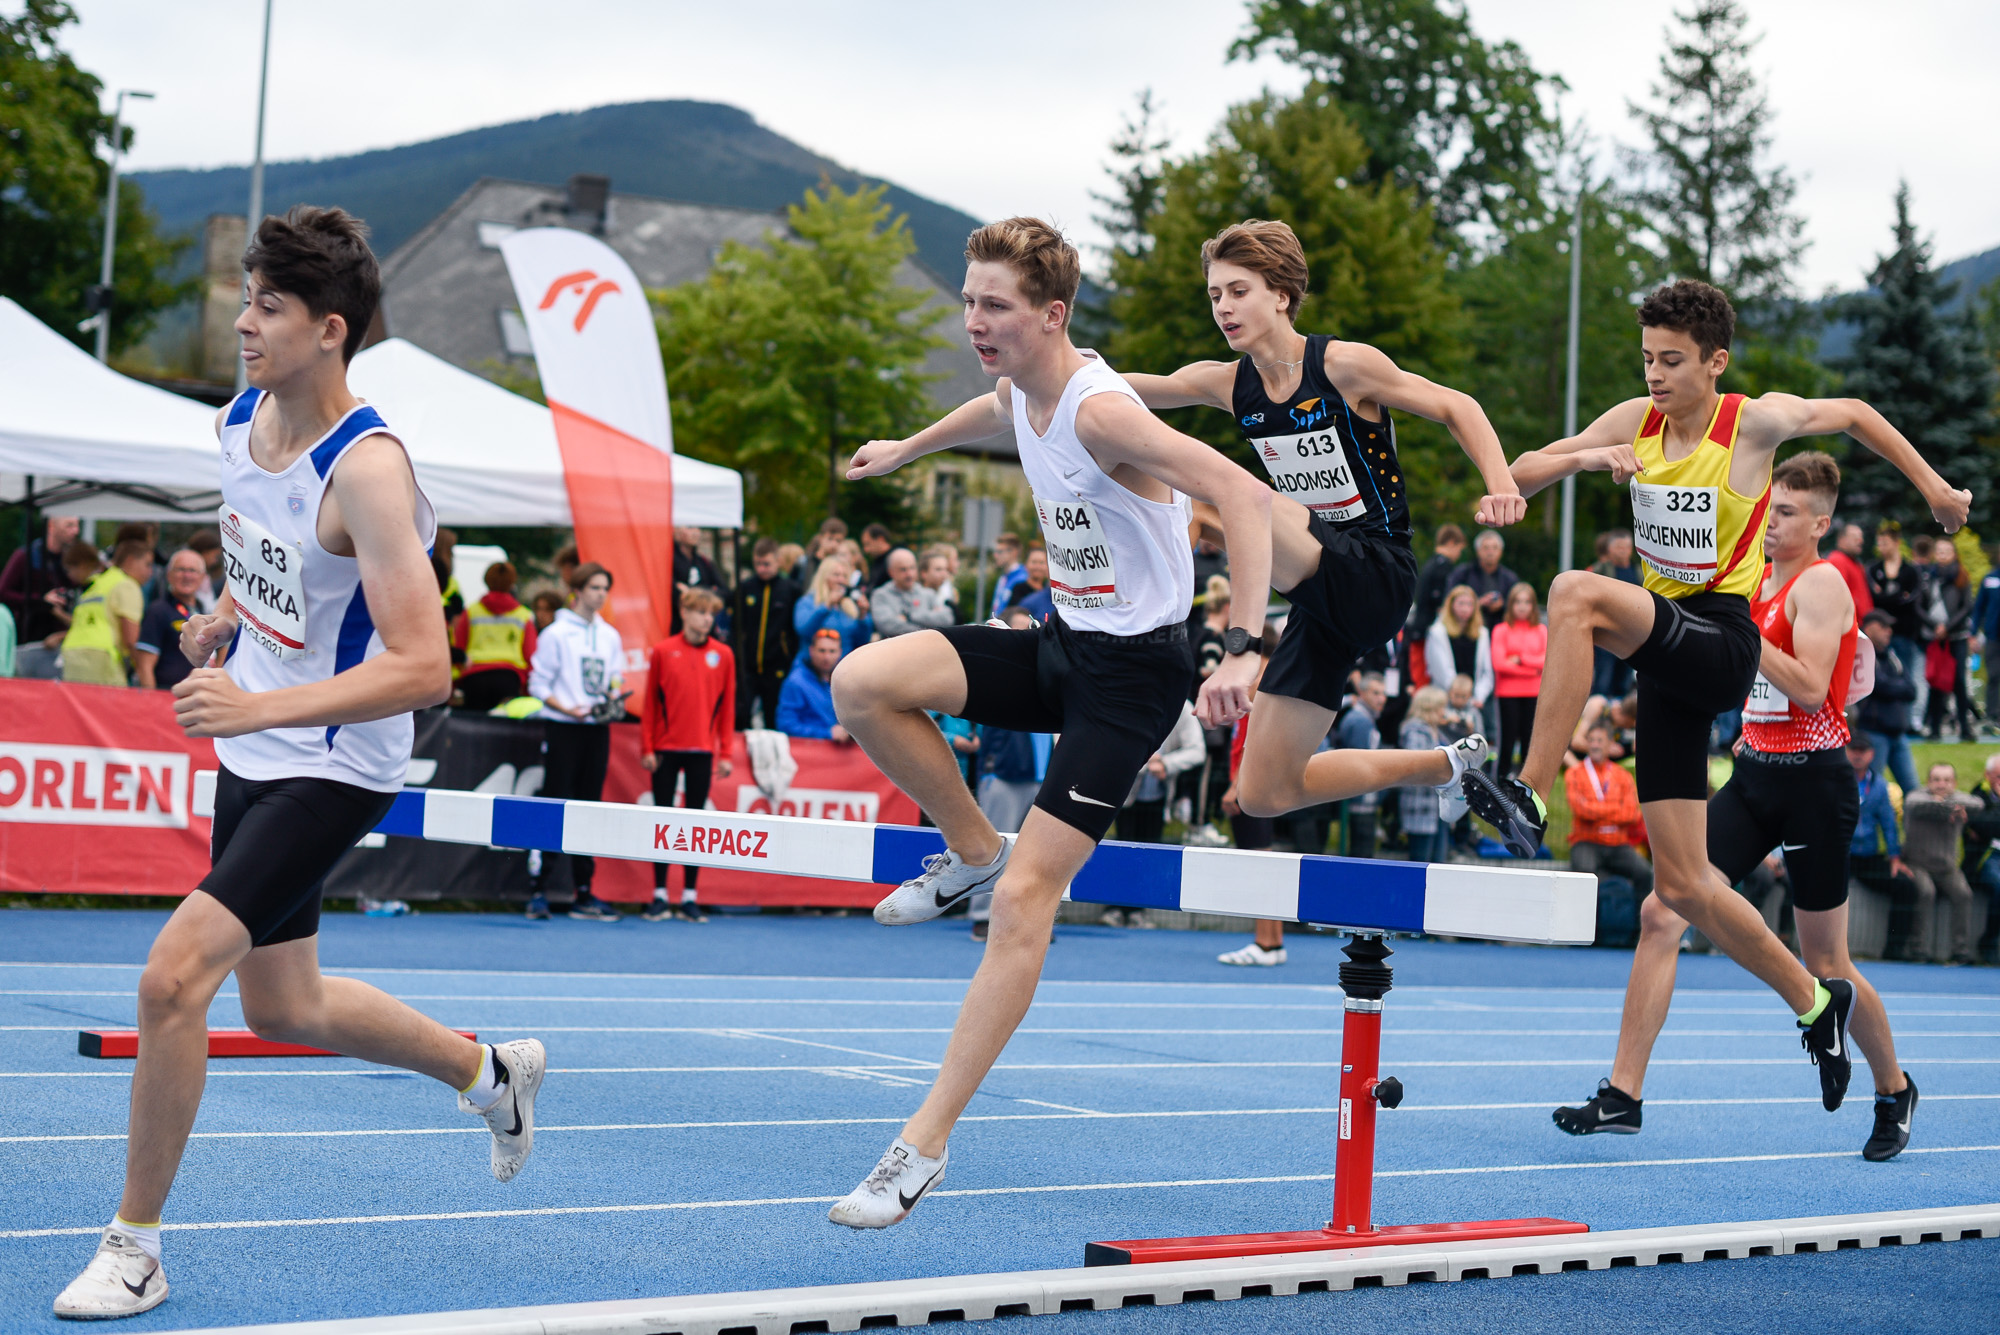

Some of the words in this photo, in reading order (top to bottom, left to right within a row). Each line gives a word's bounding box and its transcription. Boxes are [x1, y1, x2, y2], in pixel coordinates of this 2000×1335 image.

[1289, 398, 1327, 431] Sopot
[1296, 434, 1336, 458] 613
[1275, 465, 1350, 493] ADOMSKI
[1666, 490, 1712, 512] 323
[1055, 507, 1091, 531] 684
[1328, 508, 1351, 520] 2021
[1634, 515, 1713, 549] PŁUCIENNIK
[261, 538, 287, 574] 83
[1678, 571, 1701, 582] 2021
[1082, 596, 1104, 609] 2021
[0, 757, 173, 815] ORLEN
